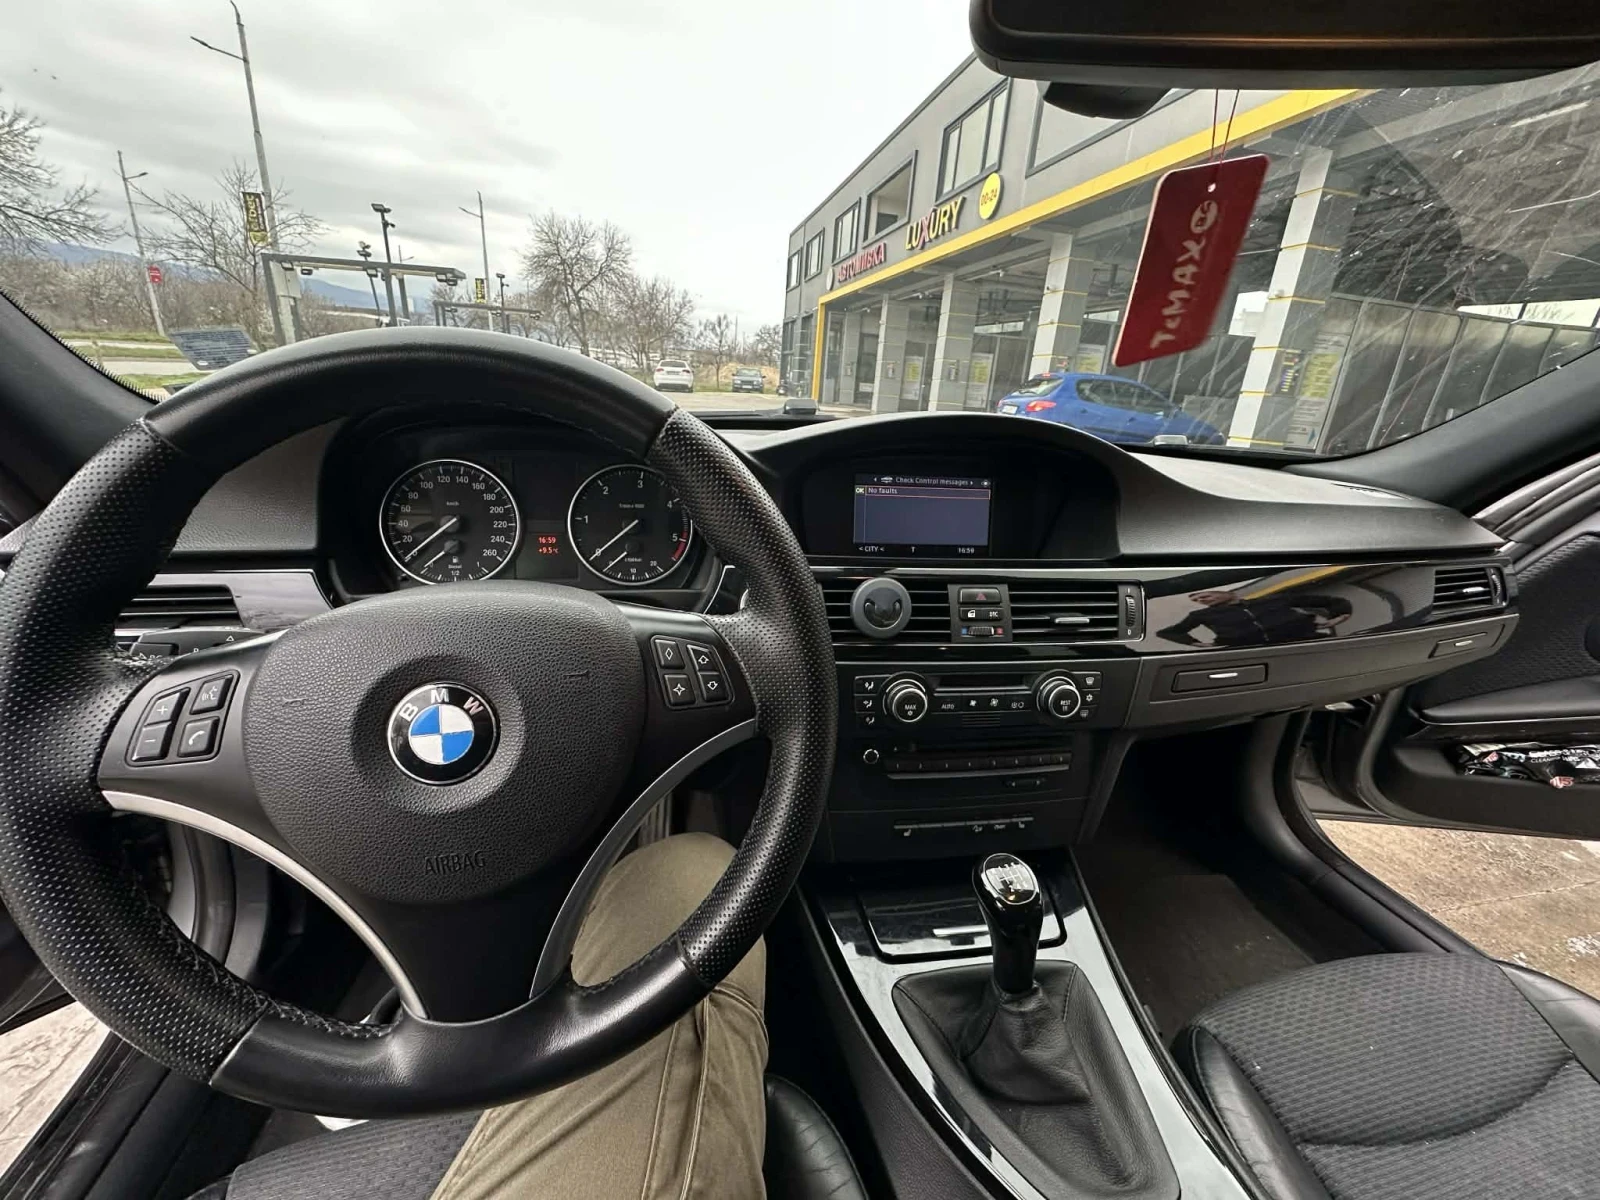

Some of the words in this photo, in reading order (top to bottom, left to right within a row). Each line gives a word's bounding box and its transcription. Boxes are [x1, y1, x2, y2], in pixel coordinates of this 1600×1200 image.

[905, 196, 966, 250] LUXURY
[437, 475, 450, 483] 120
[456, 476, 469, 484] 140
[420, 481, 433, 489] 100
[472, 482, 485, 490] 160
[637, 480, 643, 489] 3
[602, 486, 609, 495] 2
[483, 493, 496, 501] 180
[400, 505, 411, 513] 60
[666, 501, 673, 509] 4
[489, 506, 504, 514] 200
[583, 515, 589, 524] 1
[398, 520, 409, 528] 40
[493, 520, 508, 528] 220
[402, 535, 413, 543] 20
[490, 535, 505, 543] 240
[538, 536, 557, 544] 16:59
[672, 533, 678, 542] 5
[483, 549, 497, 557] 260
[399, 688, 484, 722] BMW
[424, 852, 487, 876] AIRBAG
